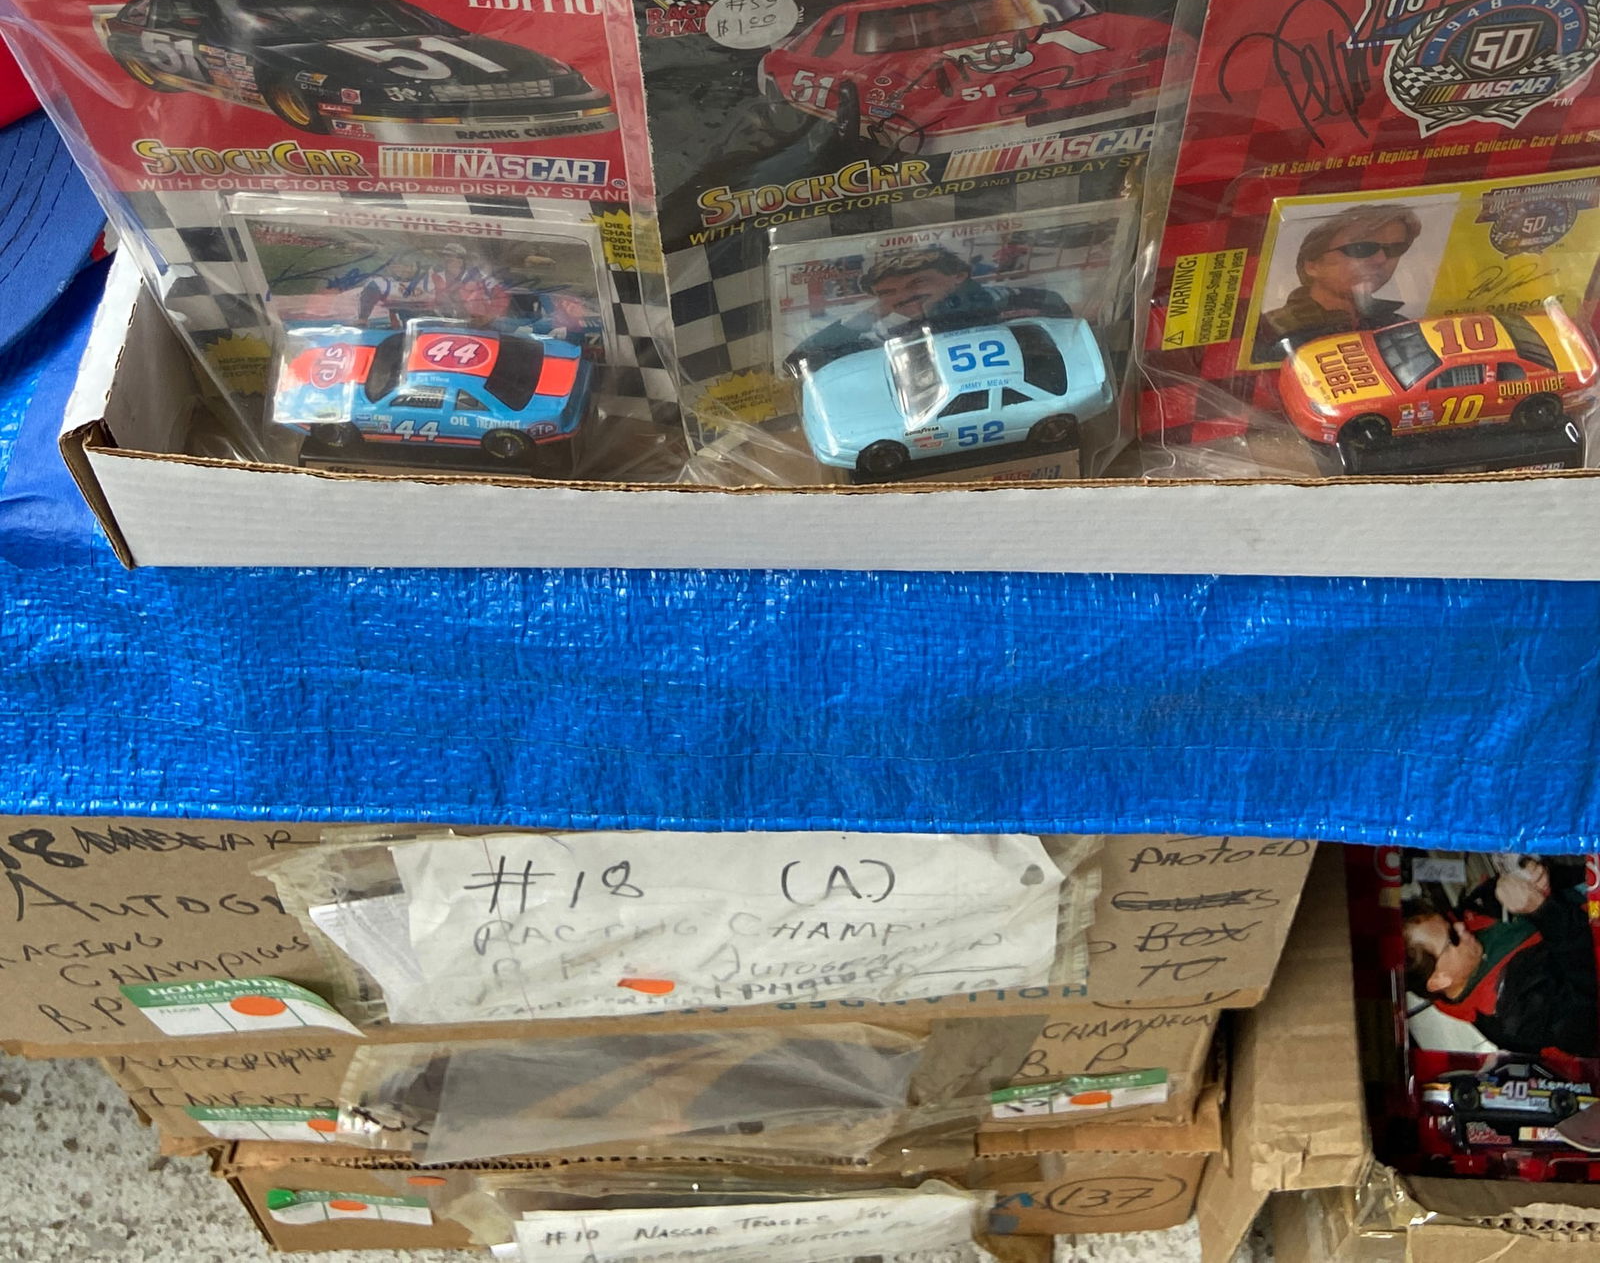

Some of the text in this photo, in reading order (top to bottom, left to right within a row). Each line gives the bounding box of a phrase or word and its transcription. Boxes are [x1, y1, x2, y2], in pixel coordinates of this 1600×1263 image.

[141, 31, 201, 82] 51
[326, 36, 509, 81] 51
[1470, 28, 1535, 70] 50
[791, 69, 835, 108] 51
[961, 84, 998, 102] 51
[1461, 75, 1551, 101] NASCAR
[1347, 134, 1556, 169] Cast Replica Card
[454, 154, 596, 184] NASCAR
[136, 178, 552, 197] WITH COLLECTORS CARD AND DISPLAY
[690, 221, 745, 246] WITH
[753, 191, 904, 229] COLLECTORS
[912, 179, 976, 200] CARD
[1014, 159, 1111, 184] DISPLAY
[1168, 255, 1199, 319] WARNING:
[1433, 315, 1498, 356] 10
[427, 340, 480, 365] 44
[948, 339, 1010, 373] 52
[1337, 340, 1380, 389] DURA
[959, 380, 982, 391] JIMMY
[1314, 351, 1357, 399] LUBE
[1498, 381, 1532, 397] DURA
[450, 416, 521, 429] OIL TREATMENT
[1437, 394, 1485, 427] 10
[394, 420, 440, 442] 44
[529, 423, 554, 437] STP
[957, 420, 1006, 448] 52
[1137, 920, 1263, 953] BOX
[1138, 956, 1229, 988] TO
[1501, 1080, 1529, 1100] 40
[1057, 1187, 1156, 1209] 137
